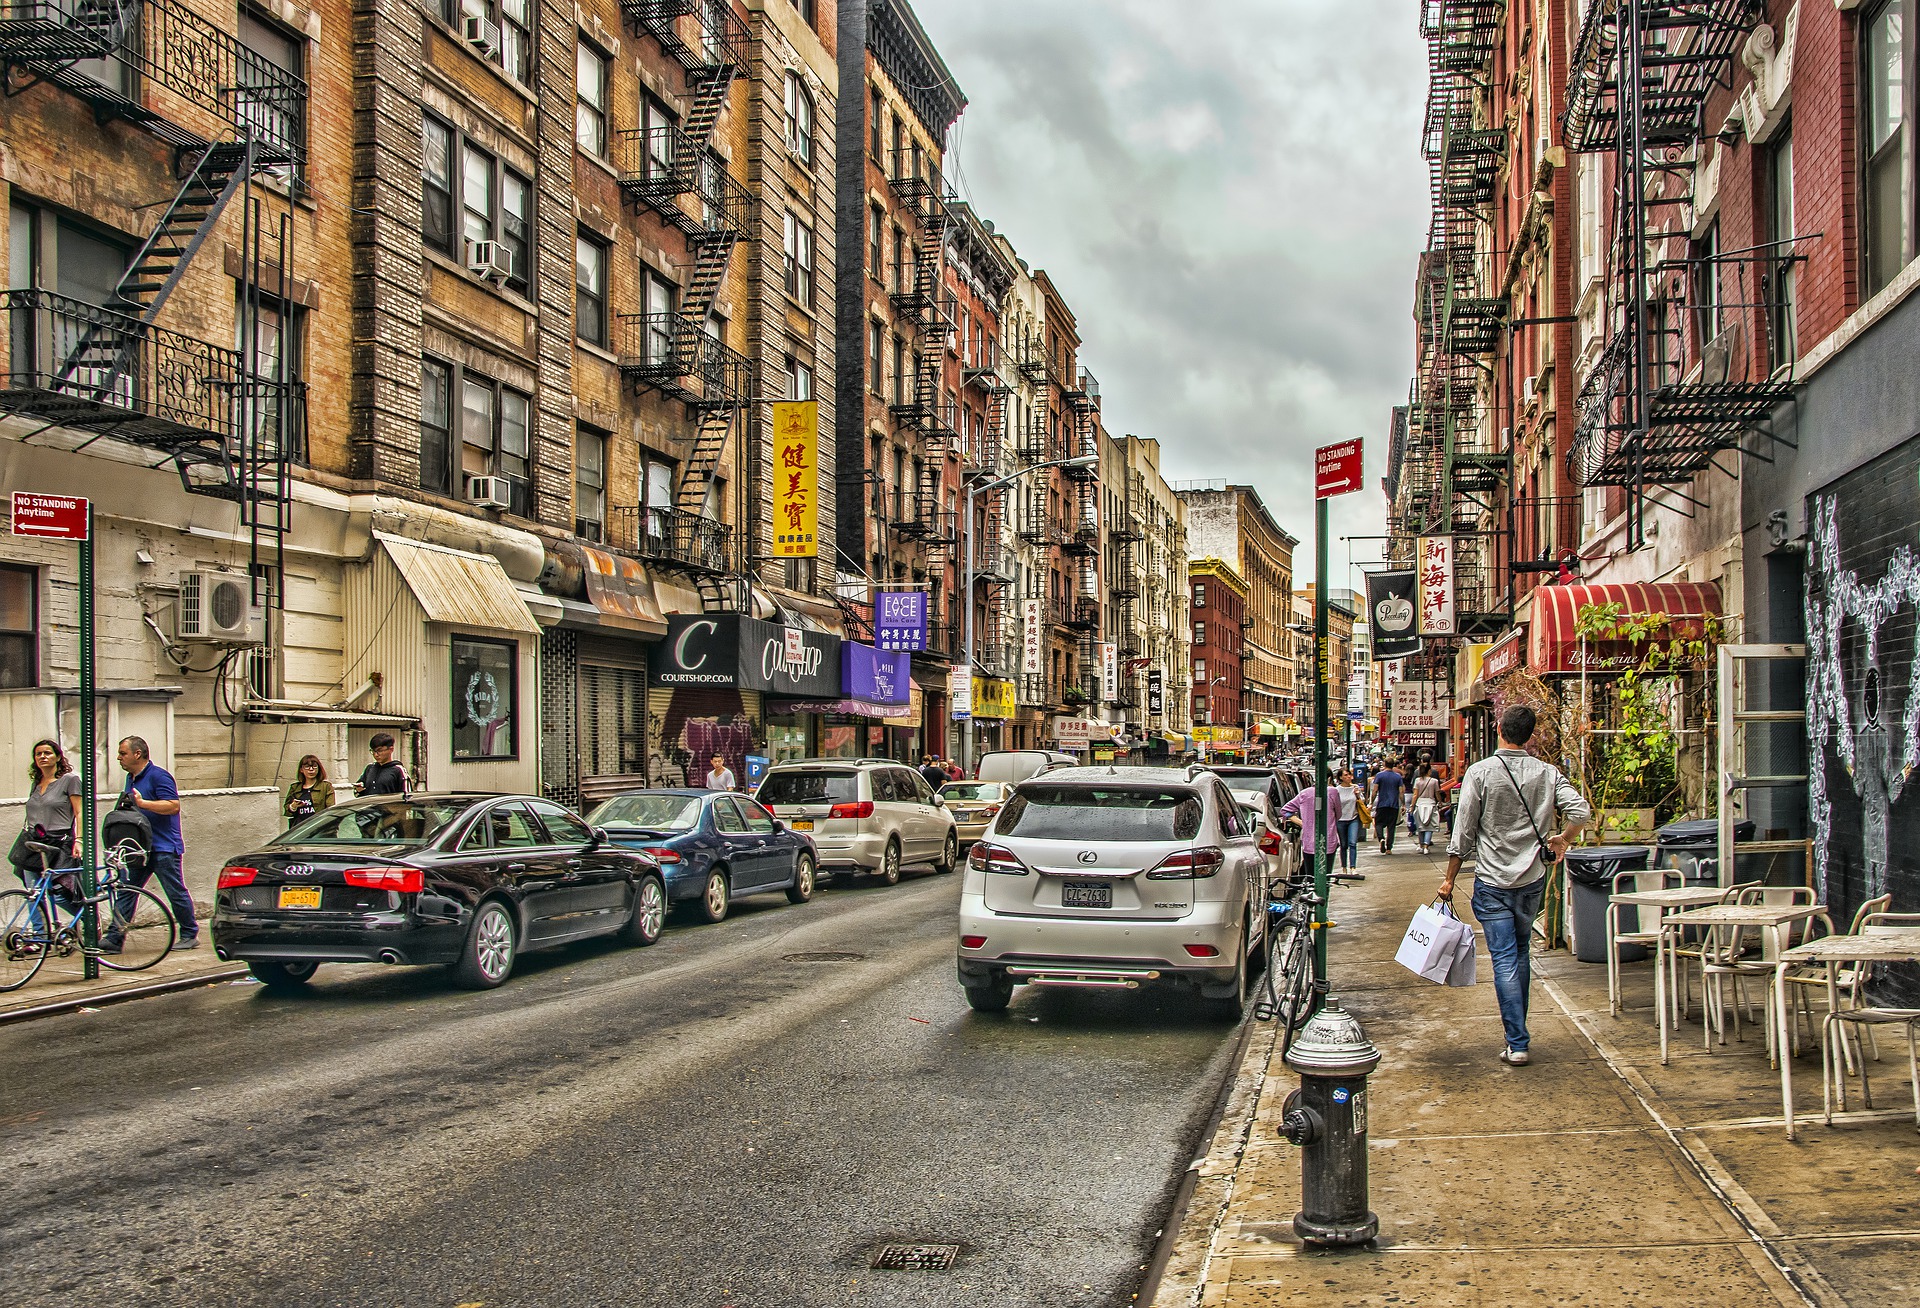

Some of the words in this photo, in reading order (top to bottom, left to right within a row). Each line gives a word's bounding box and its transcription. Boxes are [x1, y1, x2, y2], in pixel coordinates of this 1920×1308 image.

[1318, 452, 1327, 463] NO
[1327, 445, 1355, 461] STANDING
[1318, 462, 1342, 475] Anytime
[781, 442, 810, 532] 健美寶
[17, 496, 31, 506] NO
[32, 498, 76, 510] STANDING
[18, 506, 55, 518] Anytime
[1420, 539, 1450, 613] 新海洋
[675, 620, 718, 671] C
[660, 673, 733, 684] COURTSHOP.COM
[474, 691, 491, 703] KIDA
[1407, 929, 1430, 947] ALDO
